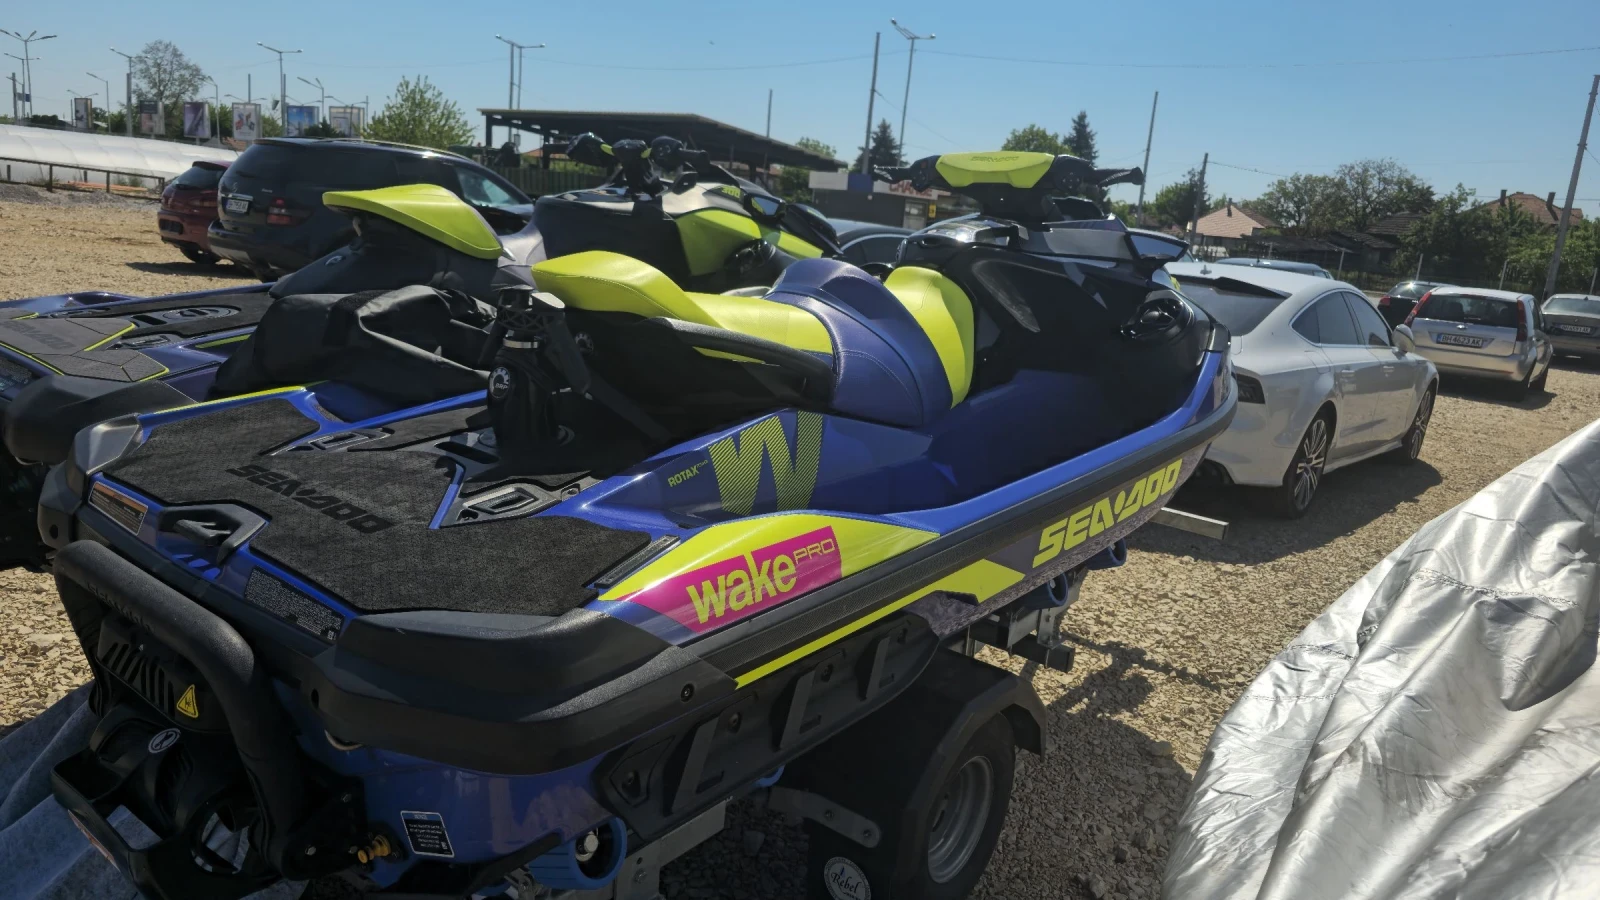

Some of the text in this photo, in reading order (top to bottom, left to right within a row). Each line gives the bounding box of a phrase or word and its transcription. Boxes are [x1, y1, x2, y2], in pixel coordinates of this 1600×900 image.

[668, 465, 699, 487] ROTAX
[686, 538, 836, 624] wake PRO
[830, 872, 862, 894] Rebel
